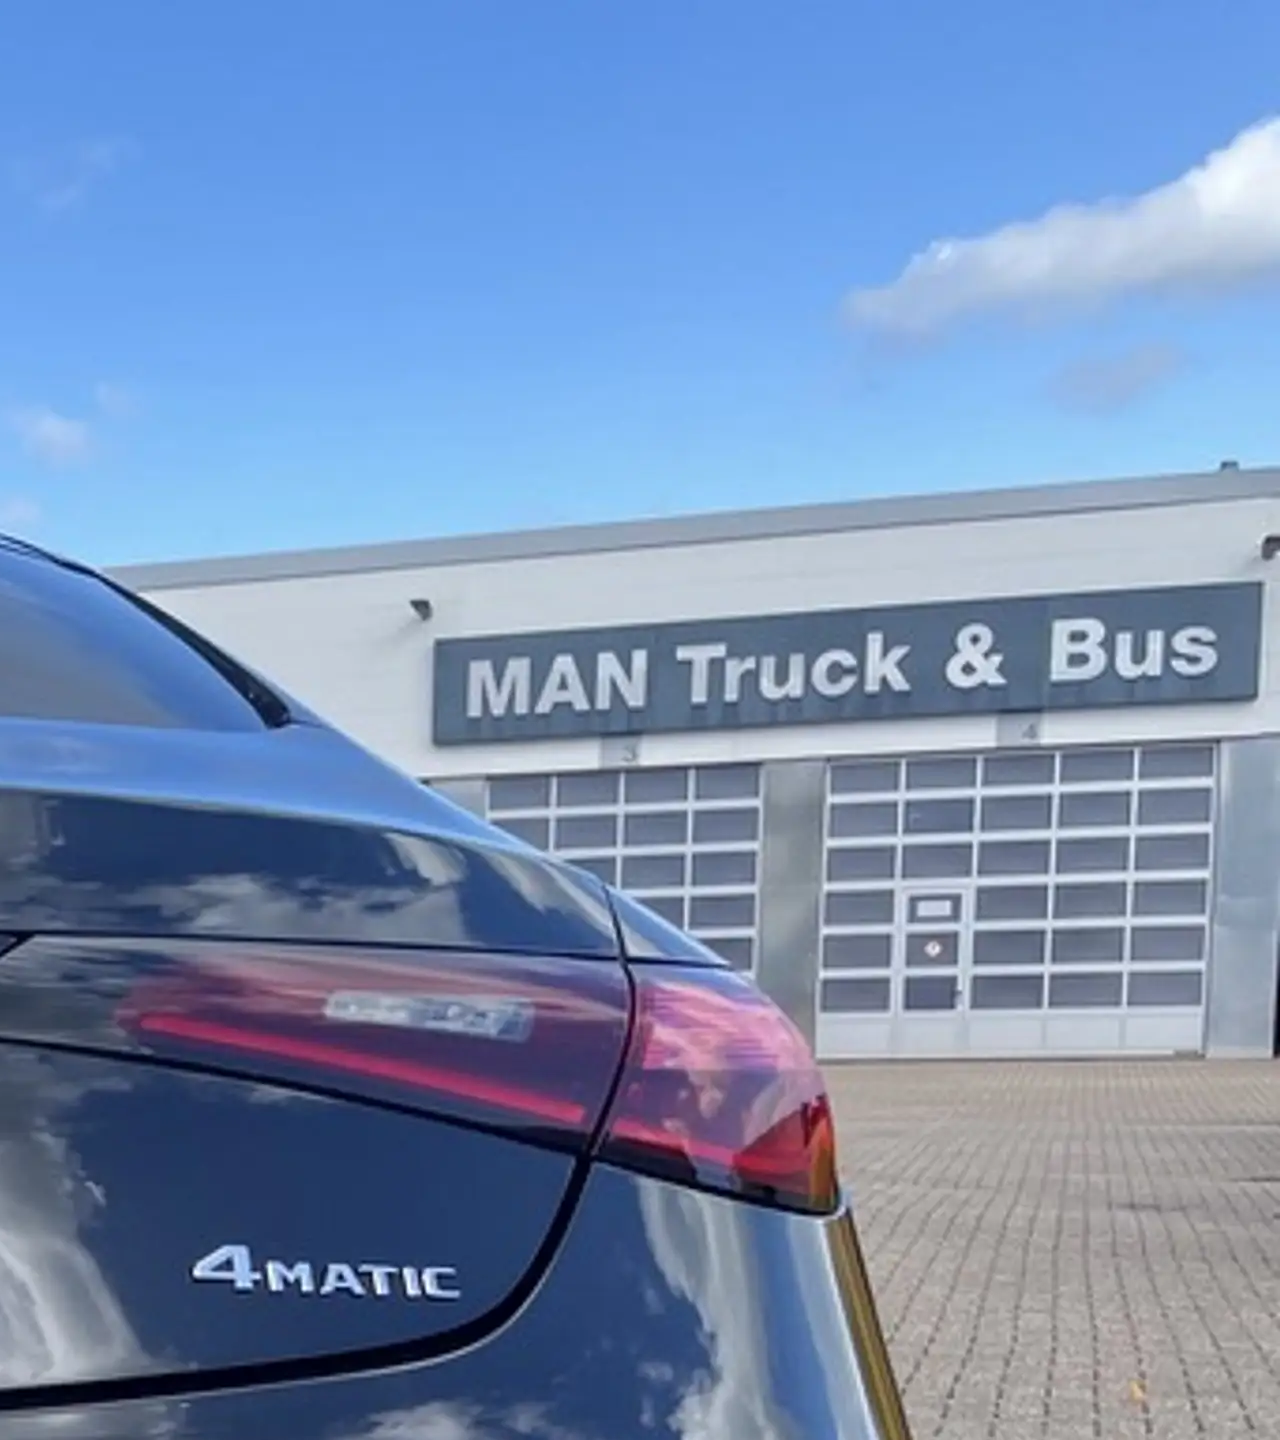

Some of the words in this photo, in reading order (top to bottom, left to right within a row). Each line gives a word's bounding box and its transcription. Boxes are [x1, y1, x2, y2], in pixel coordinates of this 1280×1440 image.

[466, 648, 649, 719] MAN
[675, 631, 912, 705] Truck
[944, 622, 1008, 690] &
[1048, 616, 1220, 684] Bus
[191, 1244, 462, 1300] 4MATIC
